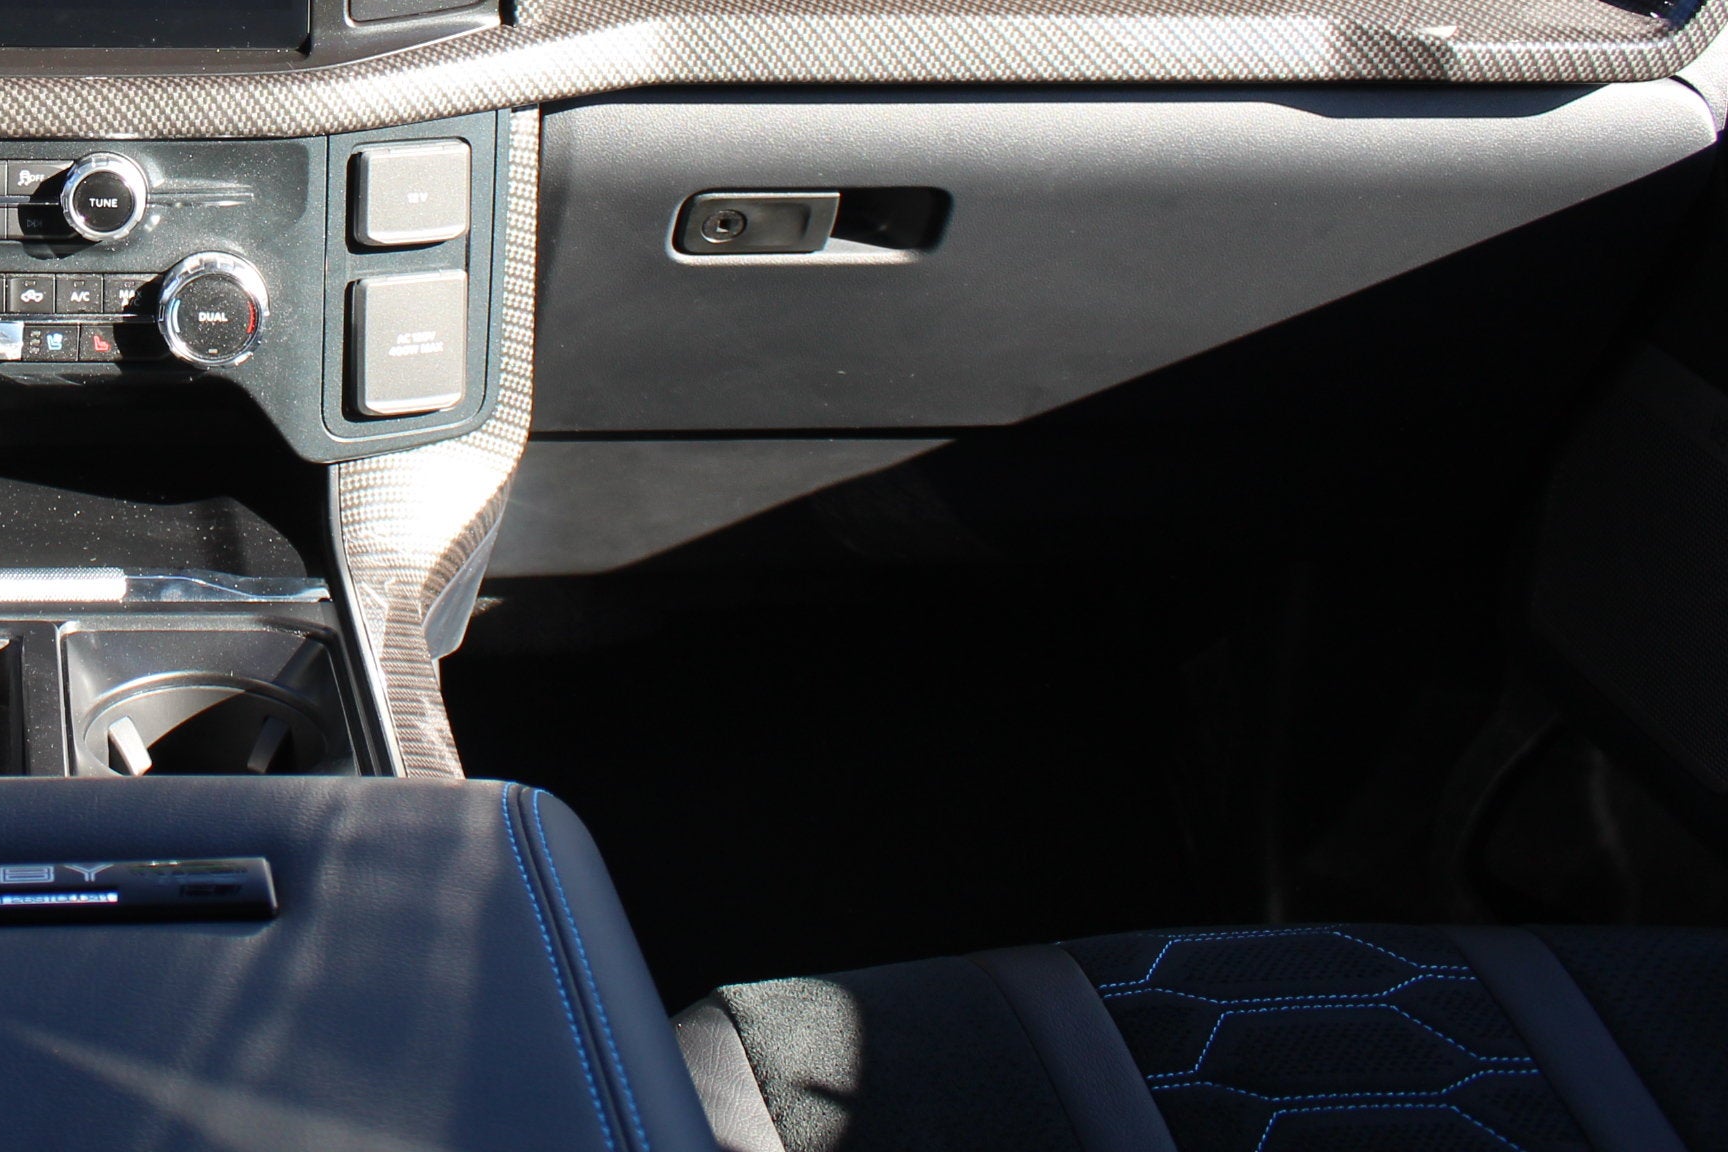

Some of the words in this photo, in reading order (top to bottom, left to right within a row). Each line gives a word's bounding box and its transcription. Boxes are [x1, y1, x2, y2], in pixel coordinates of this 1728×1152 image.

[29, 174, 45, 182] OFF
[89, 198, 118, 208] TUNE
[71, 291, 90, 302] A/C
[198, 312, 228, 322] DUAL
